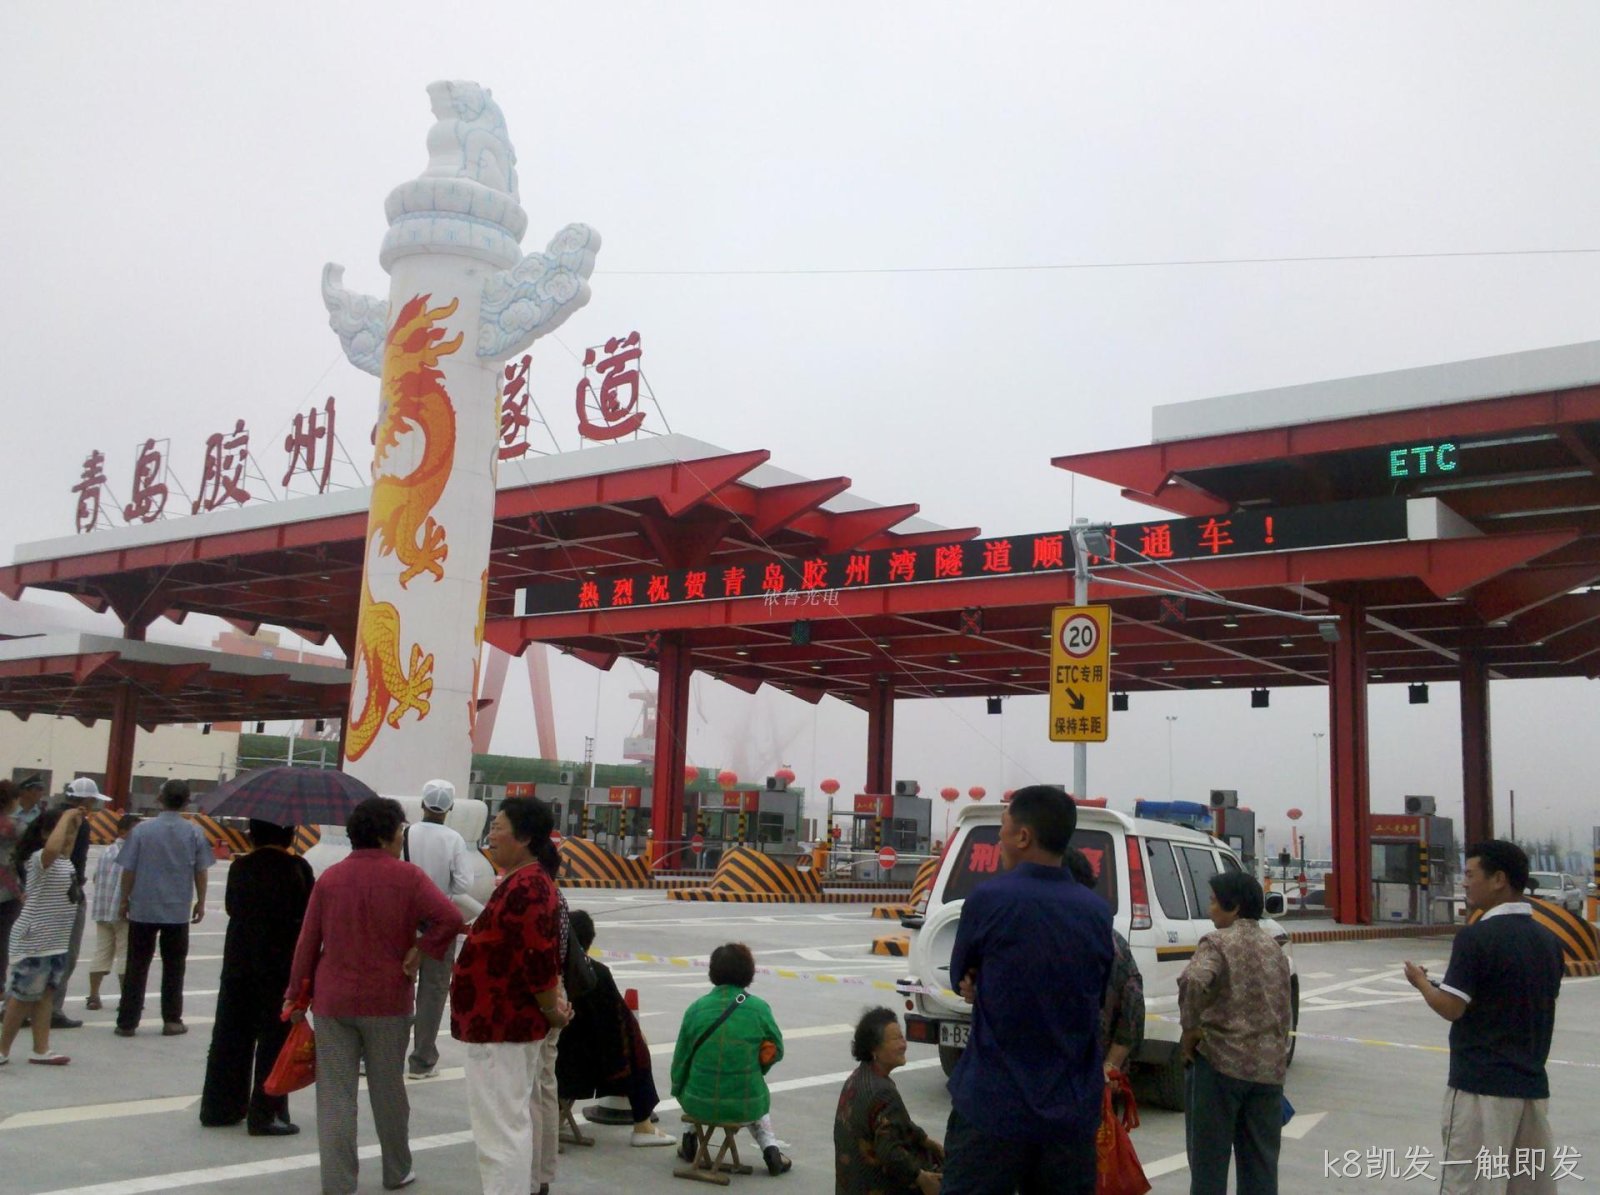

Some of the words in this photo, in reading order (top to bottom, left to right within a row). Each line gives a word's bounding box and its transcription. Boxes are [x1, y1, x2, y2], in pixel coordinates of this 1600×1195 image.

[1390, 443, 1456, 477] ETC
[1069, 625, 1093, 647] 20
[1056, 664, 1103, 684] ETC专用
[1055, 716, 1102, 735] 保持车距
